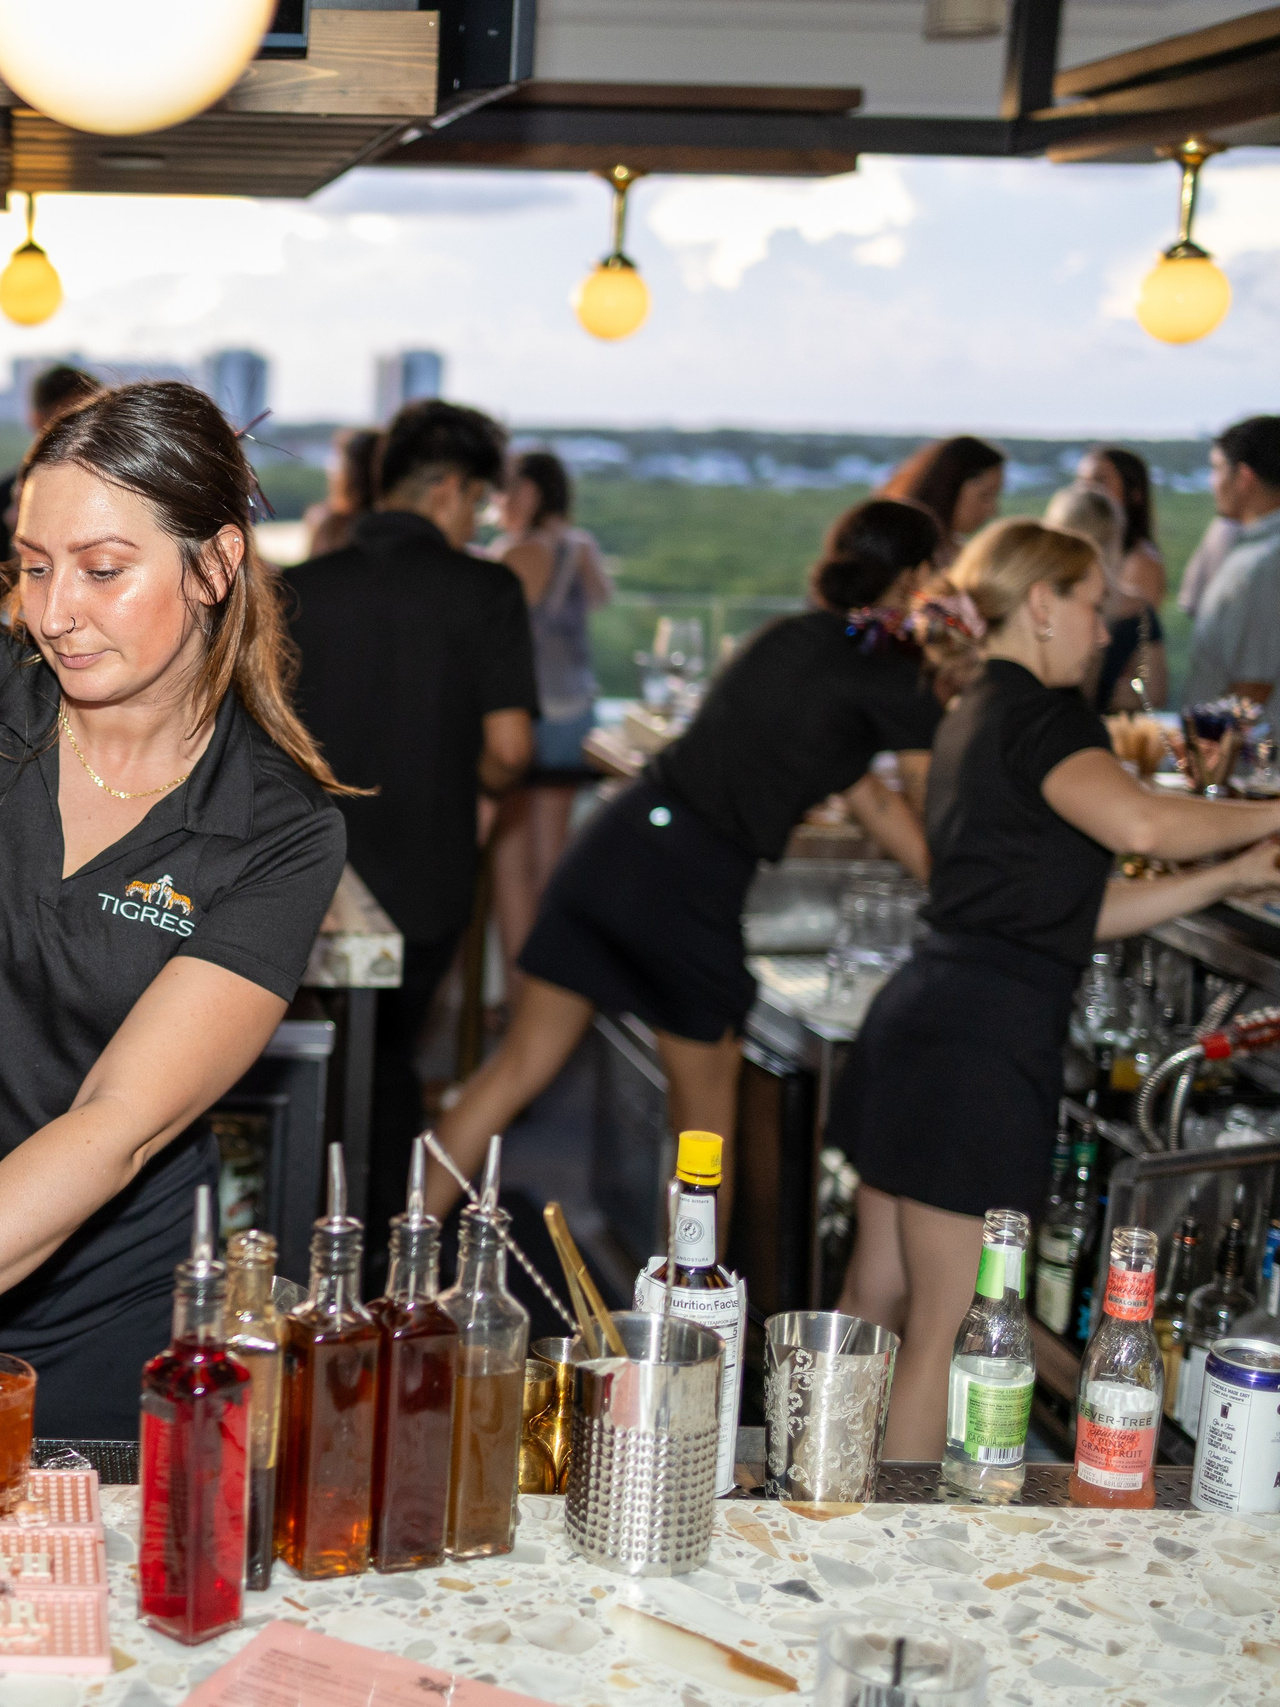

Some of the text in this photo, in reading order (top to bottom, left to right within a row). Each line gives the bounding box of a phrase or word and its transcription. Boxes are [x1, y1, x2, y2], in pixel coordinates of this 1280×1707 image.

[98, 892, 195, 937] TIGRES
[670, 1297, 739, 1311] utrition Facts
[1080, 1404, 1152, 1427] FEVER-TREE
[1081, 1439, 1143, 1458] GRAPEFRUIT
[1098, 1438, 1125, 1448] PINK
